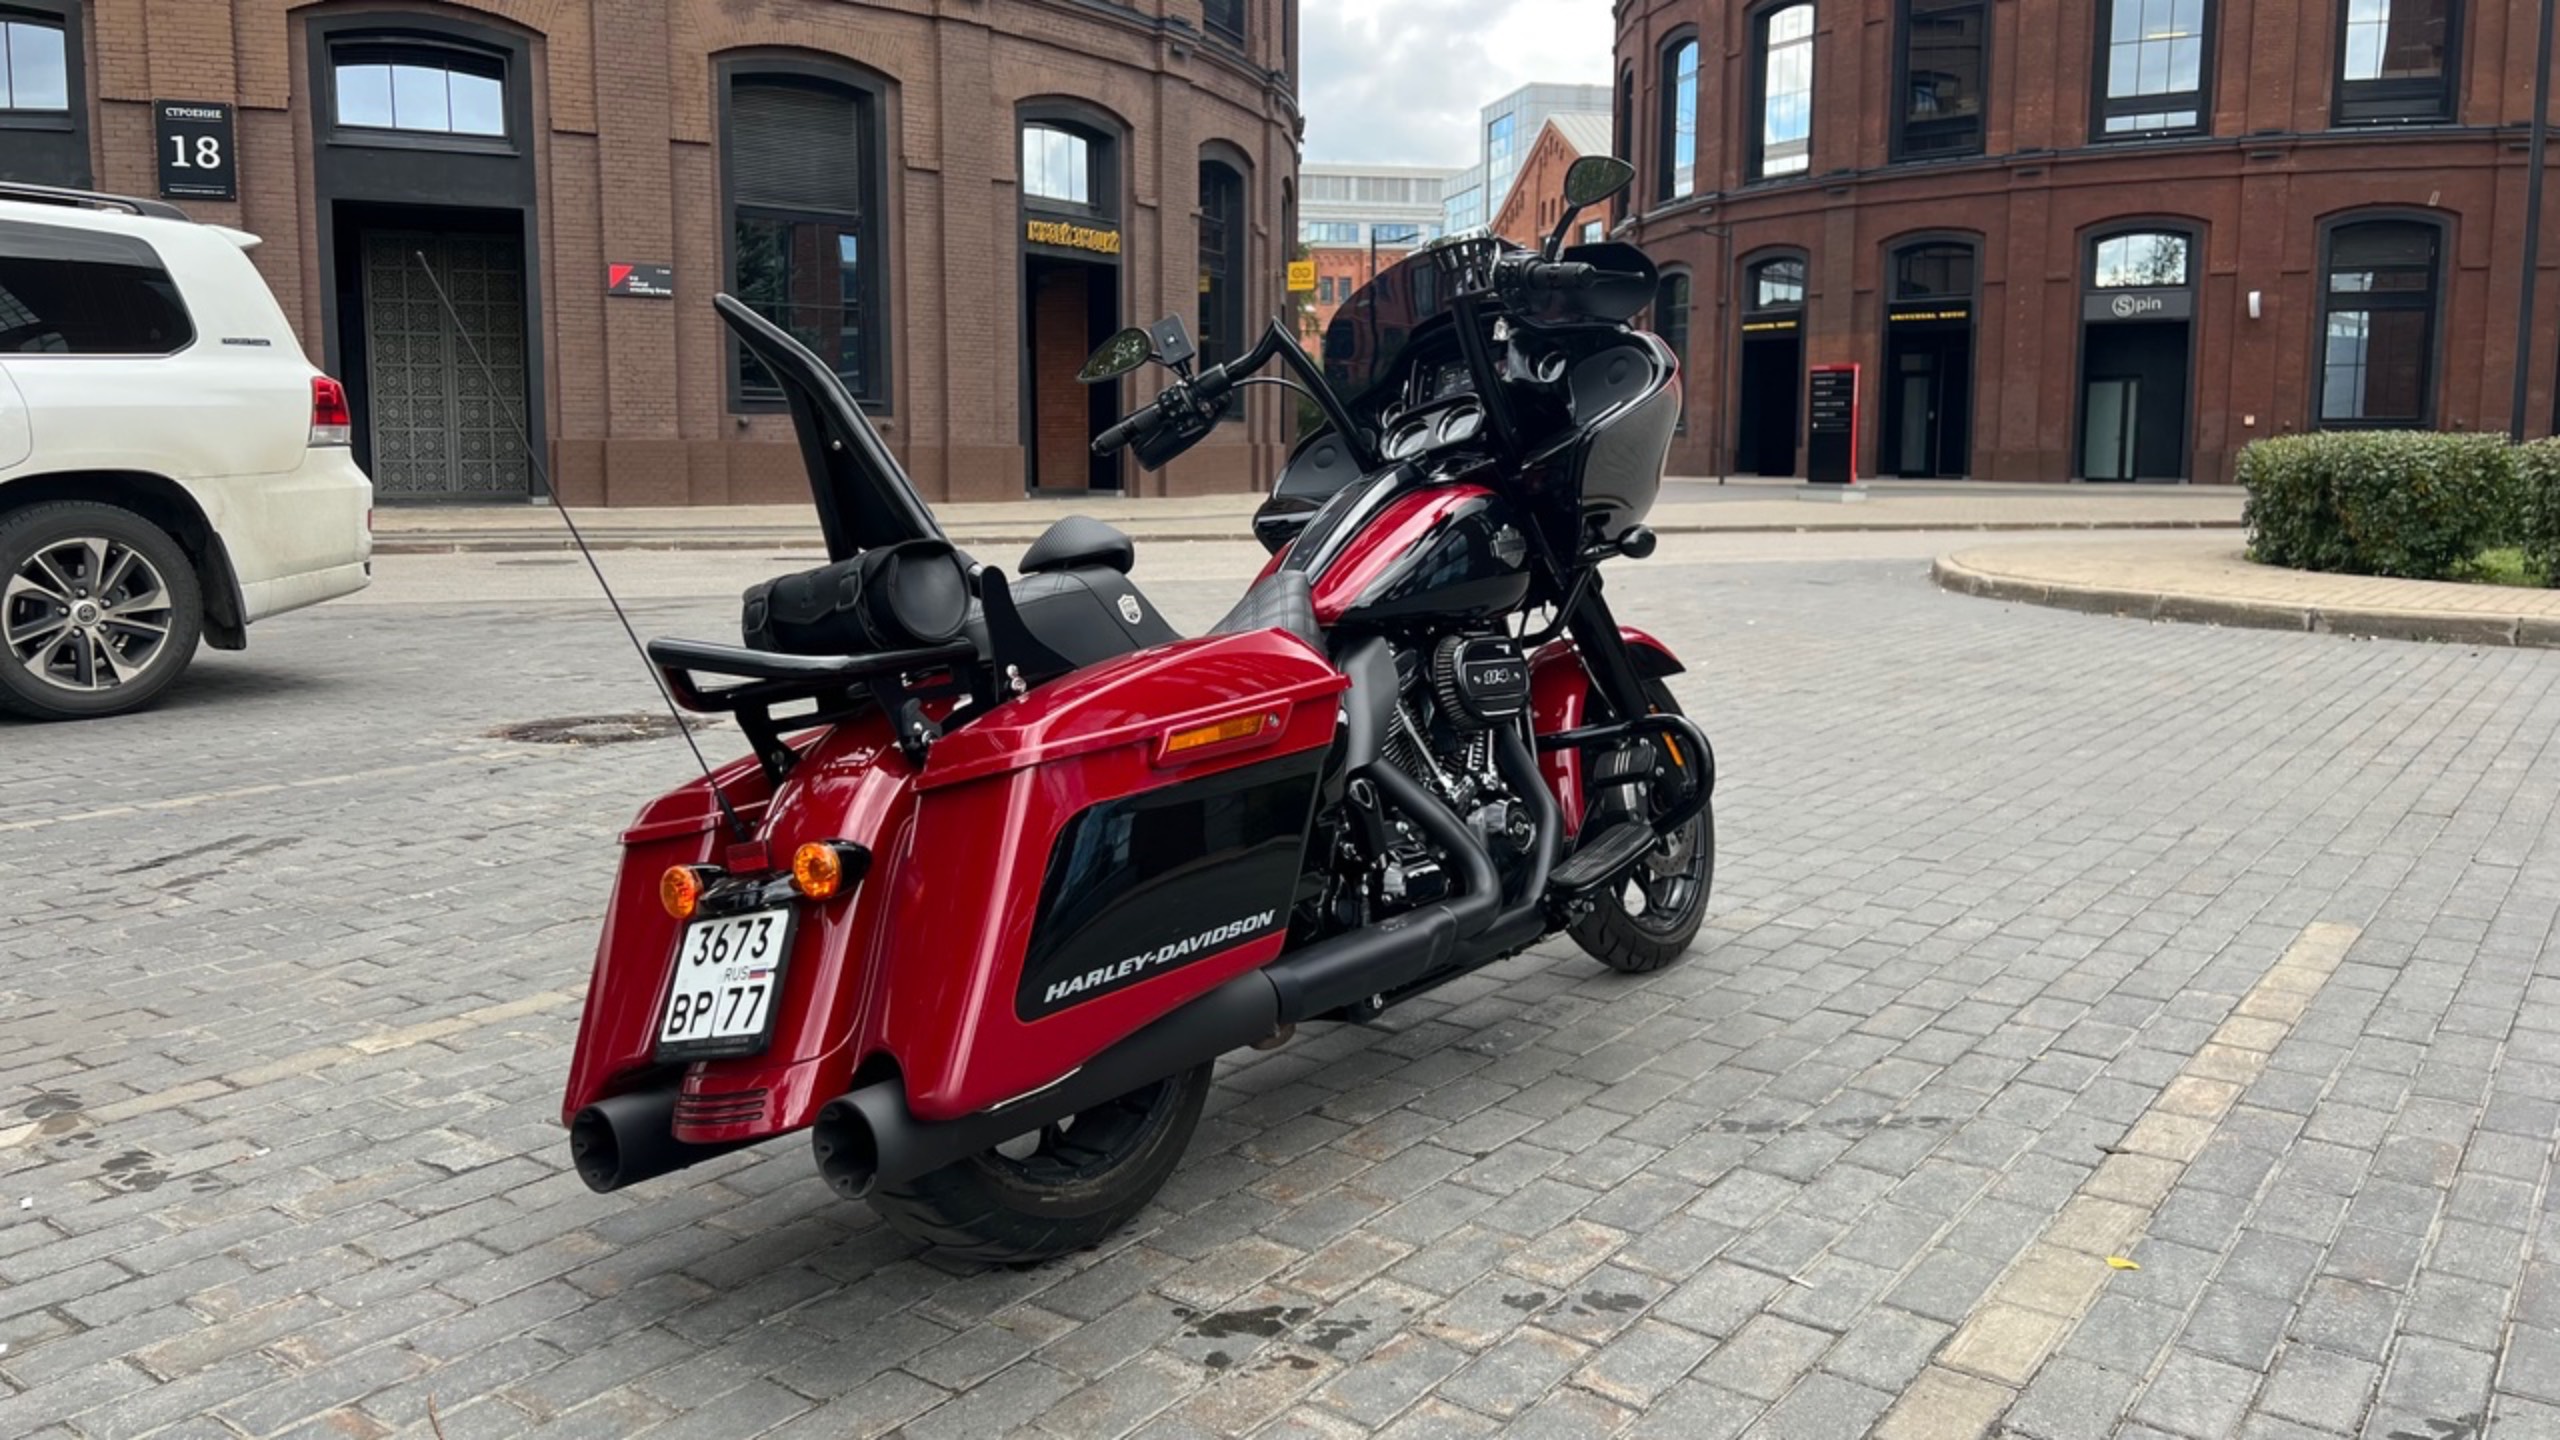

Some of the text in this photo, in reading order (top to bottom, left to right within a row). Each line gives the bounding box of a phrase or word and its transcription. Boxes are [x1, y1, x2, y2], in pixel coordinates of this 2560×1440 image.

[165, 107, 223, 119] СТРОЕНИЕ
[170, 134, 221, 169] 18
[2111, 294, 2162, 318] Spin
[693, 916, 773, 967] 3673
[1044, 909, 1276, 1003] HARLEY-DAVIDSON
[724, 966, 749, 981] RUS
[723, 985, 765, 1030] 77
